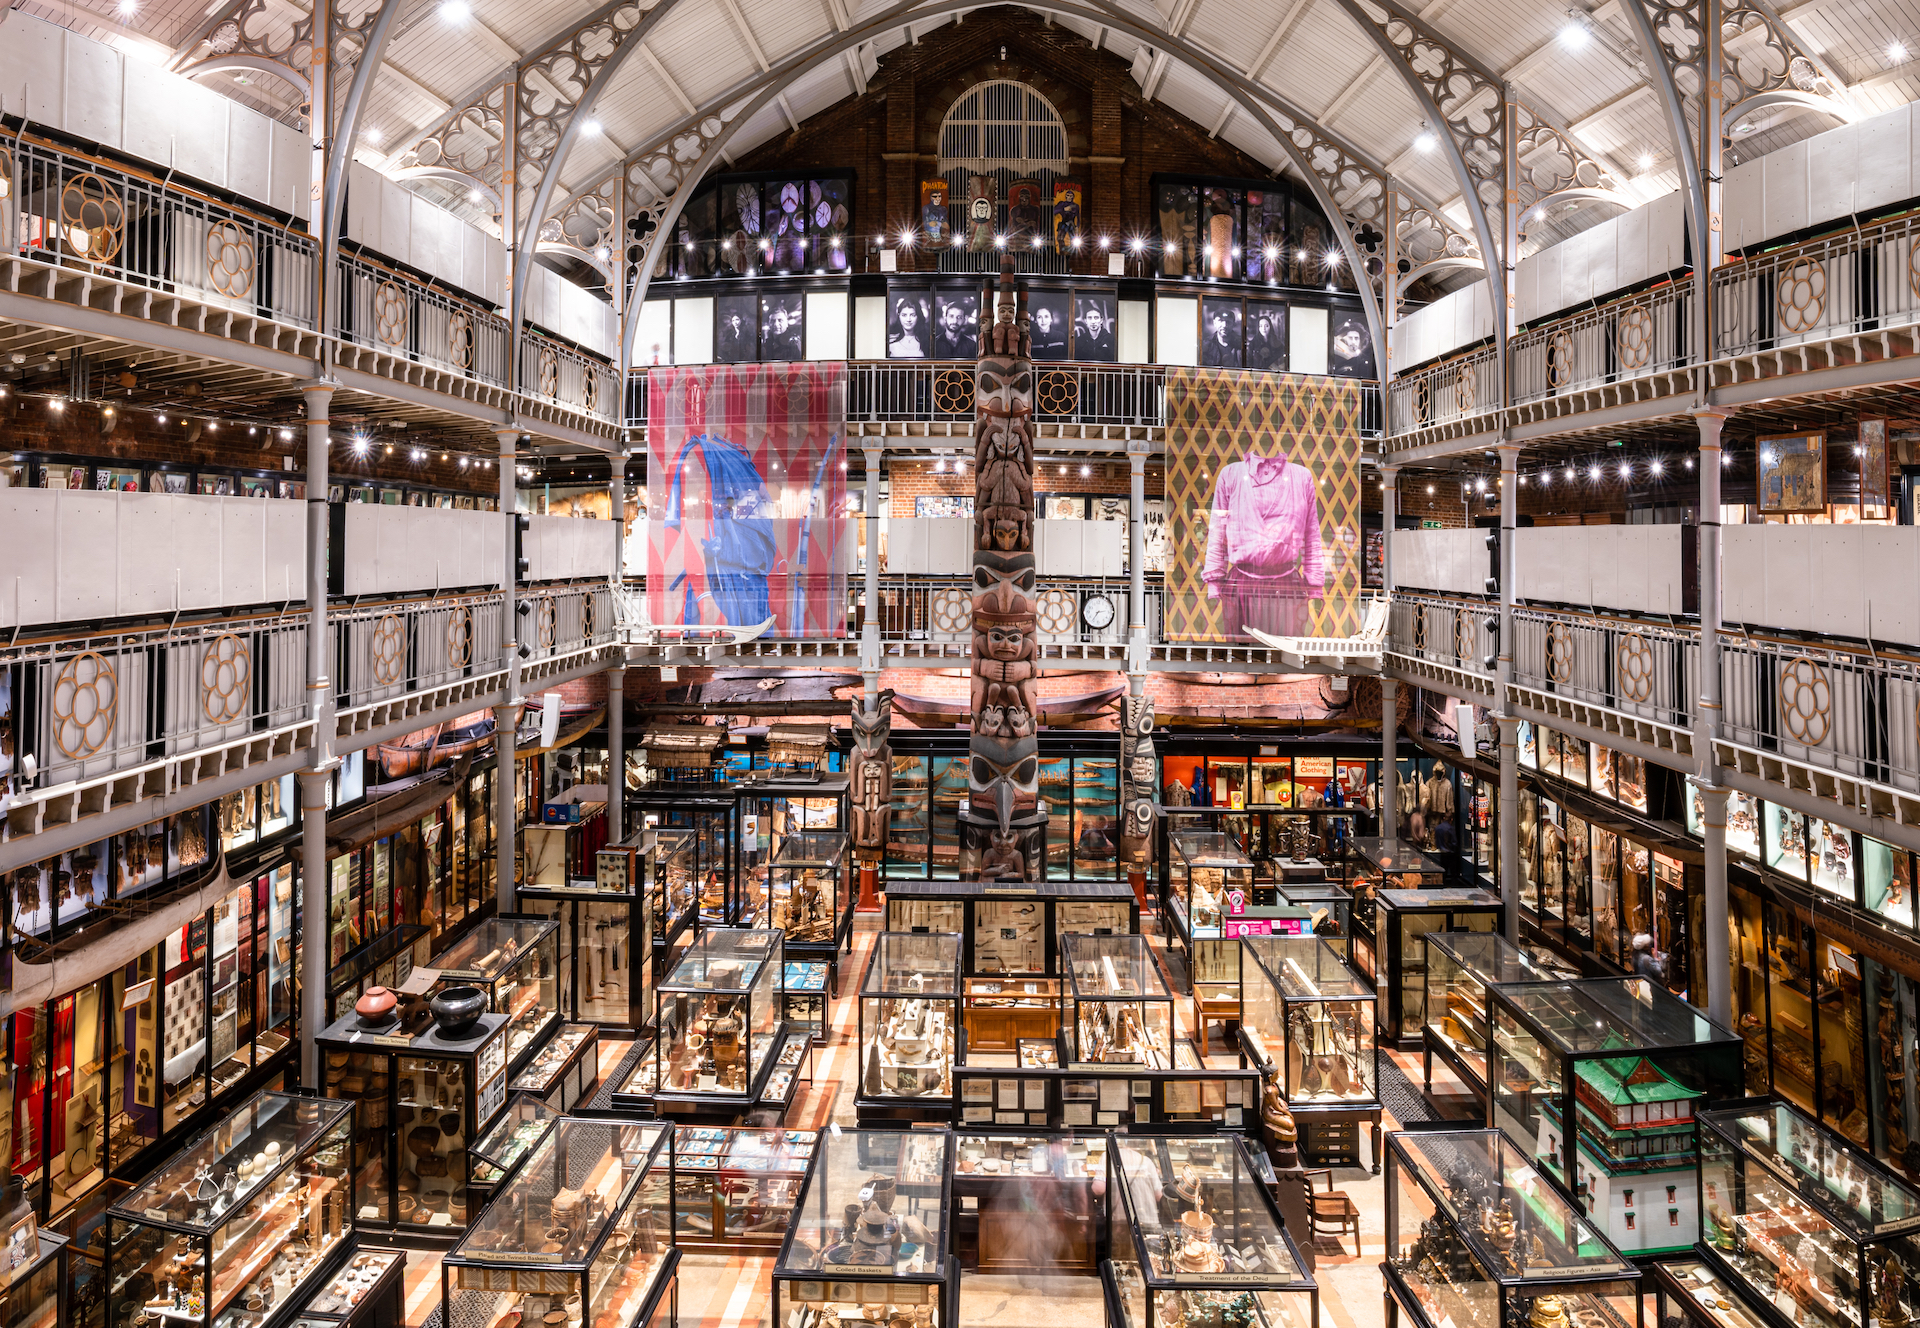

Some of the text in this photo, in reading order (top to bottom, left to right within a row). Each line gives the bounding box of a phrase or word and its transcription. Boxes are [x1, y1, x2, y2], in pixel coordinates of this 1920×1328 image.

[922, 181, 948, 193] PHANTOM
[1300, 766, 1327, 775] Clothing
[150, 1210, 164, 1219] Vessels
[1880, 1224, 1895, 1232] Religious
